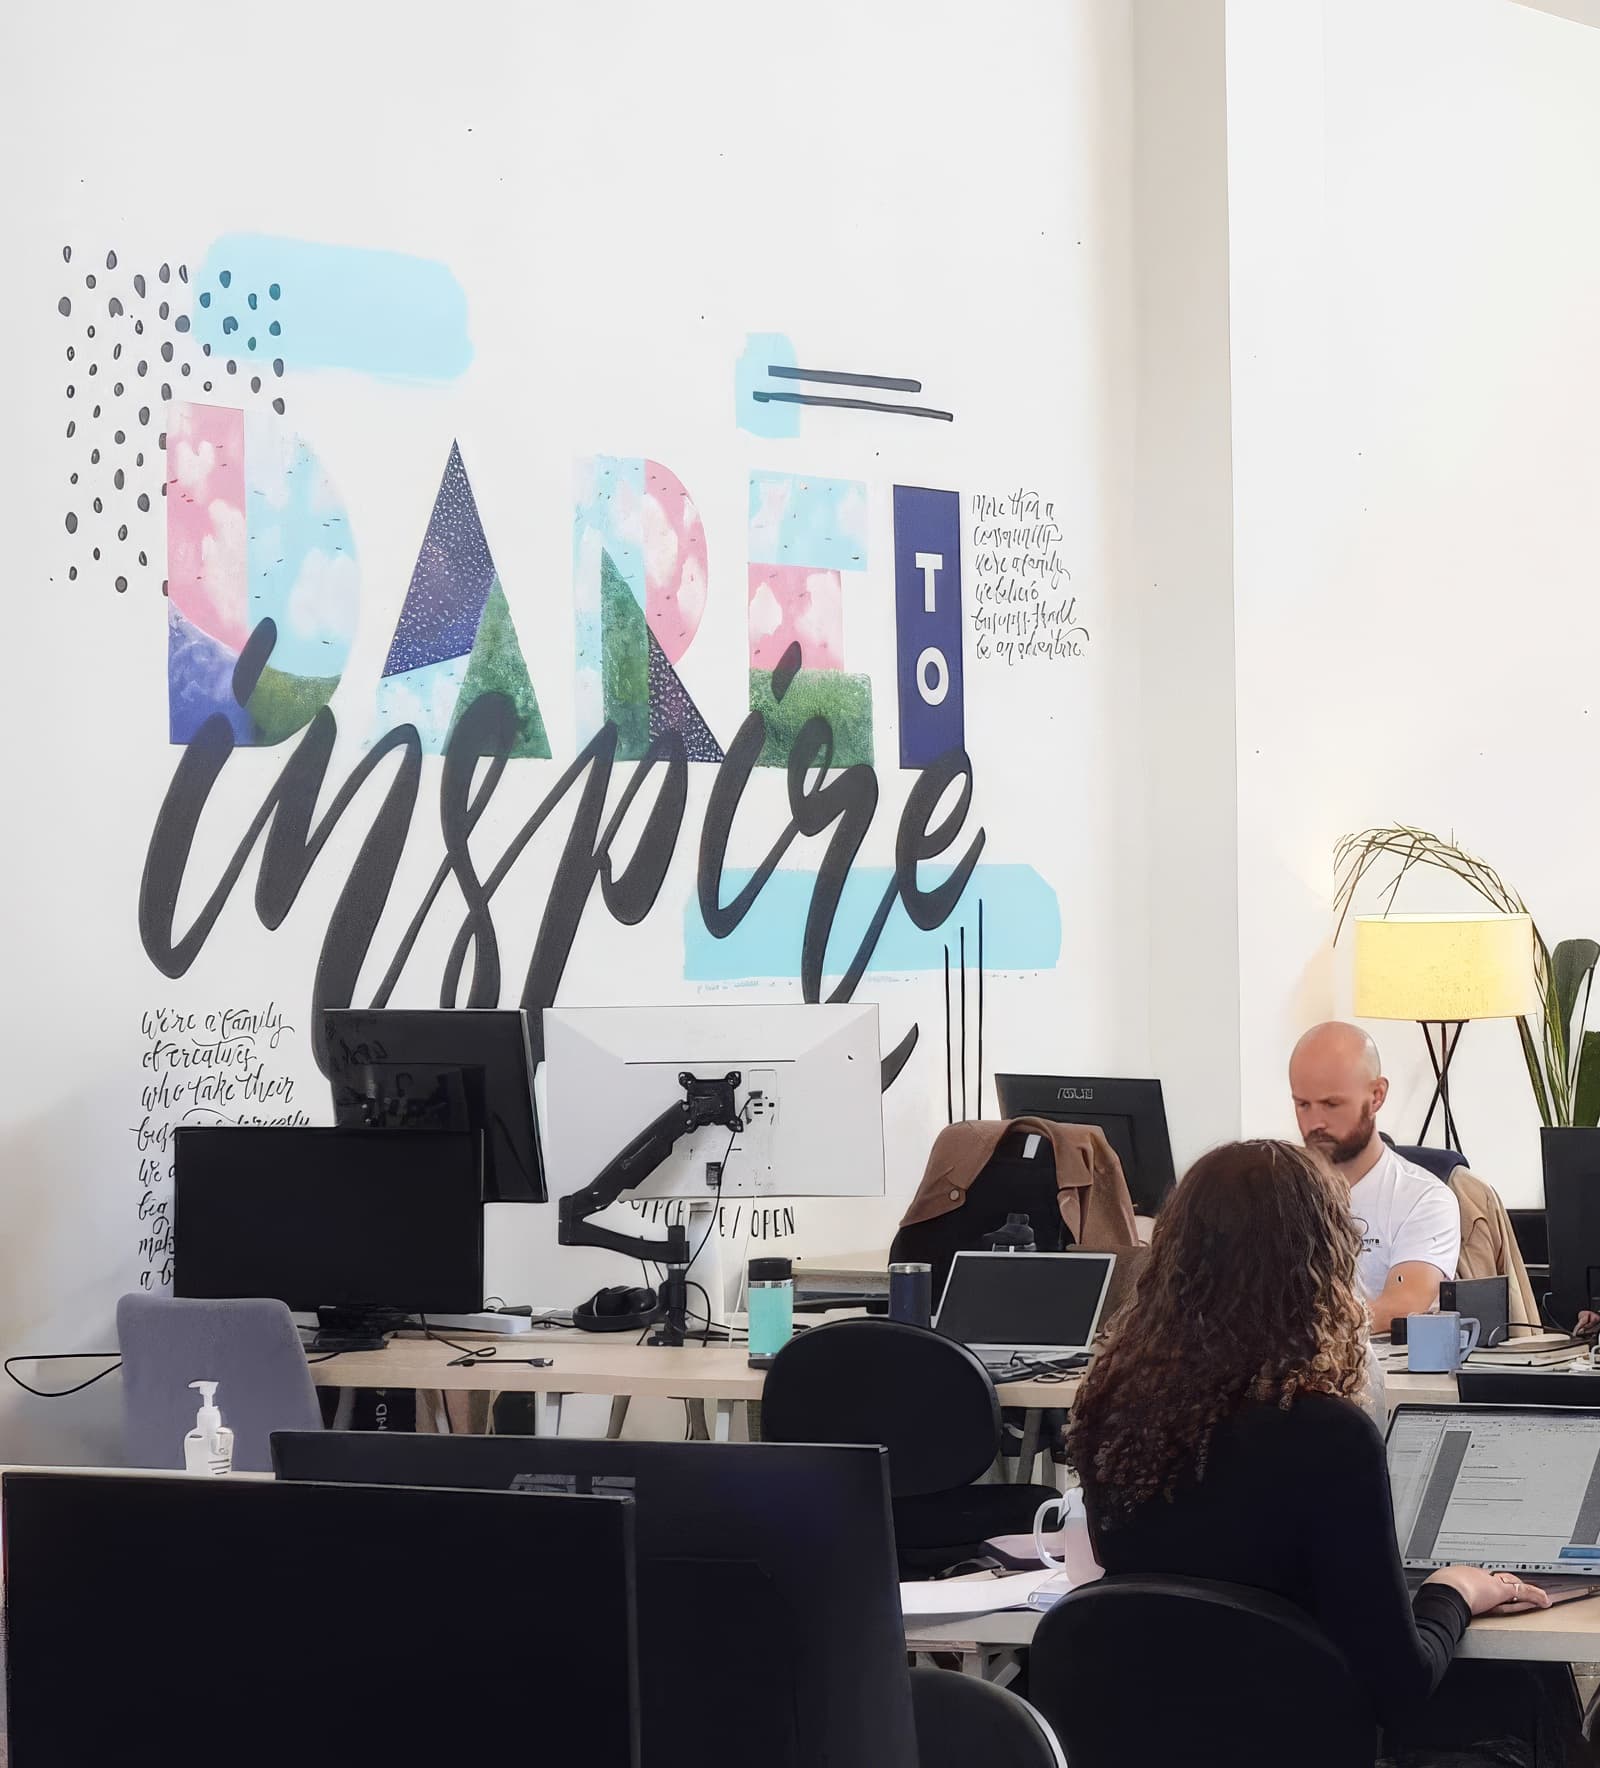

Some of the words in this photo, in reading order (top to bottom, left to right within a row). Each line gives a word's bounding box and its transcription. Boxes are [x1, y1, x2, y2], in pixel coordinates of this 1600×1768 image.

[167, 402, 873, 768] DARE
[915, 552, 950, 706] TO
[138, 617, 985, 1090] inspire
[221, 1001, 295, 1049] family
[142, 1071, 184, 1112] who
[187, 1071, 236, 1106] take
[234, 1063, 294, 1104] their
[750, 1205, 795, 1240] OPEN
